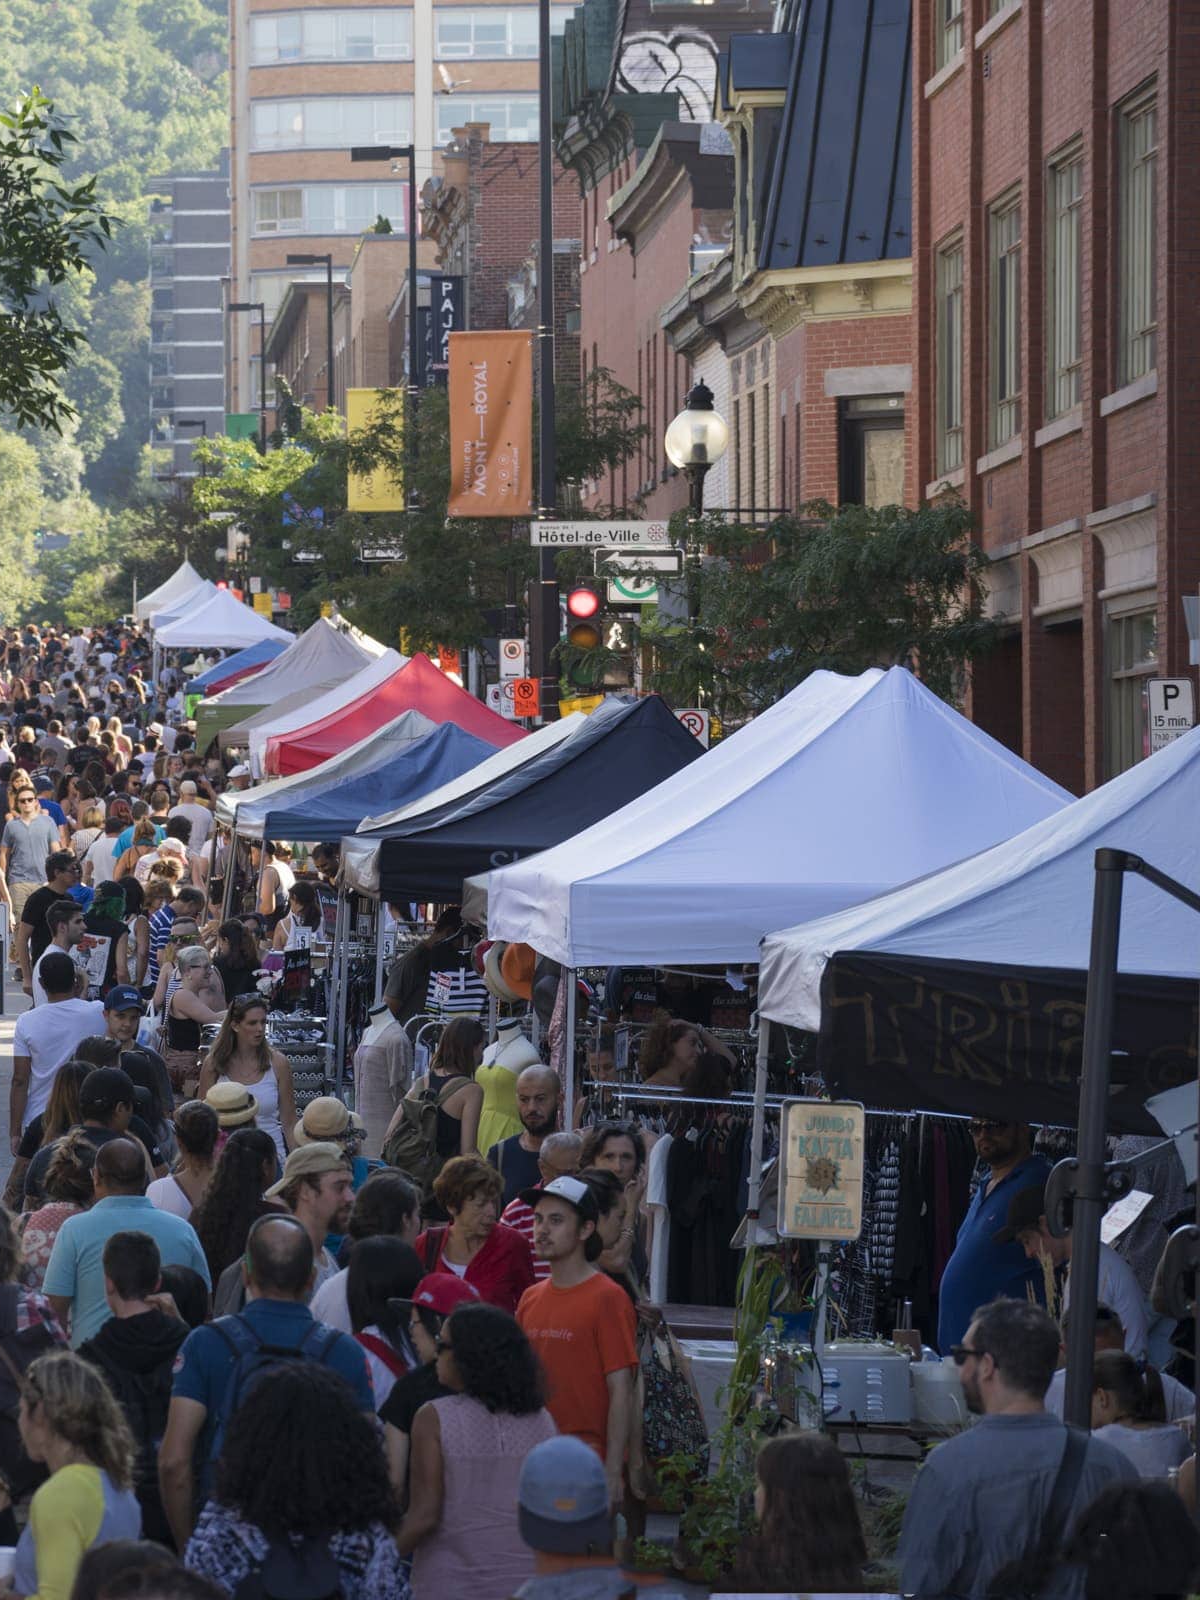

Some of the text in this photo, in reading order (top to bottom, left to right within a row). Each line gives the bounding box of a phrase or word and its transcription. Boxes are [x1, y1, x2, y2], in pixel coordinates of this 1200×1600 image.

[539, 530, 640, 543] Hôtel-de-Ville
[1163, 684, 1180, 711] P
[1154, 715, 1191, 727] 15 min.
[805, 1115, 855, 1133] JUMBO
[798, 1135, 854, 1160] KAFTA
[793, 1206, 856, 1229] FALAFEL
